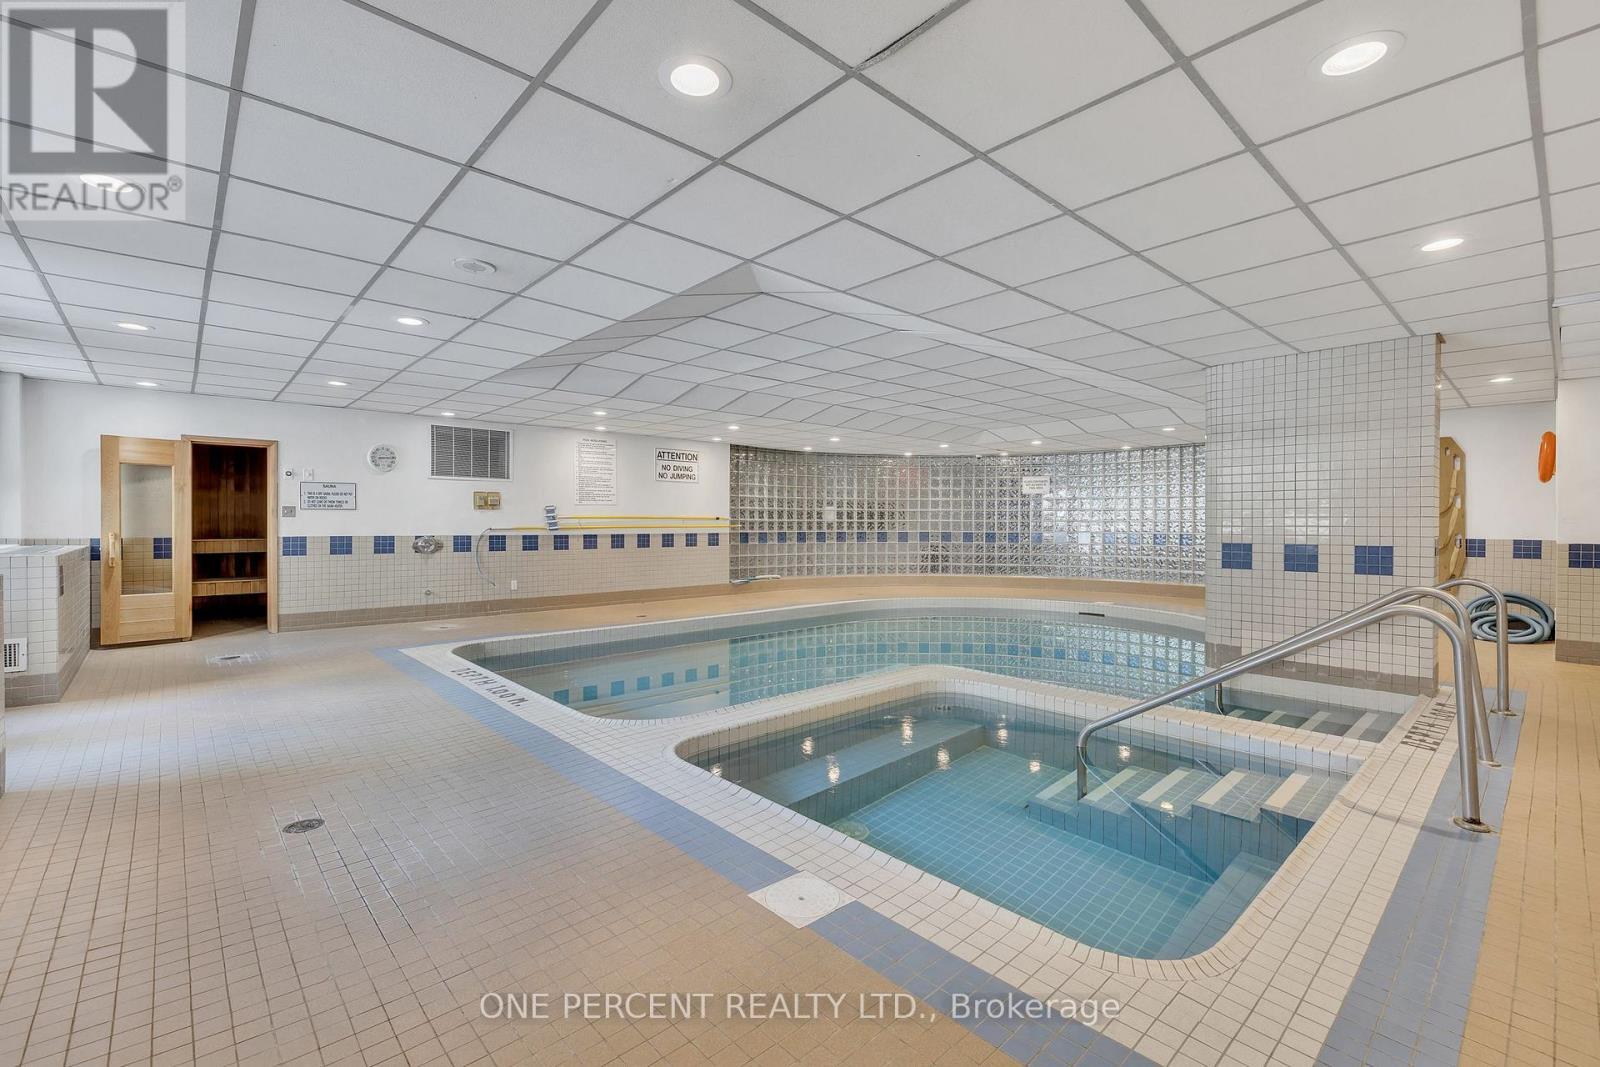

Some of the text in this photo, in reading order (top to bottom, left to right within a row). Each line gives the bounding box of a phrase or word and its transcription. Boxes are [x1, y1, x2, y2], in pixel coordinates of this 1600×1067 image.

[657, 451, 698, 461] ATTENTION
[450, 667, 498, 686] DEPTH
[1400, 720, 1450, 752] DEPTH
